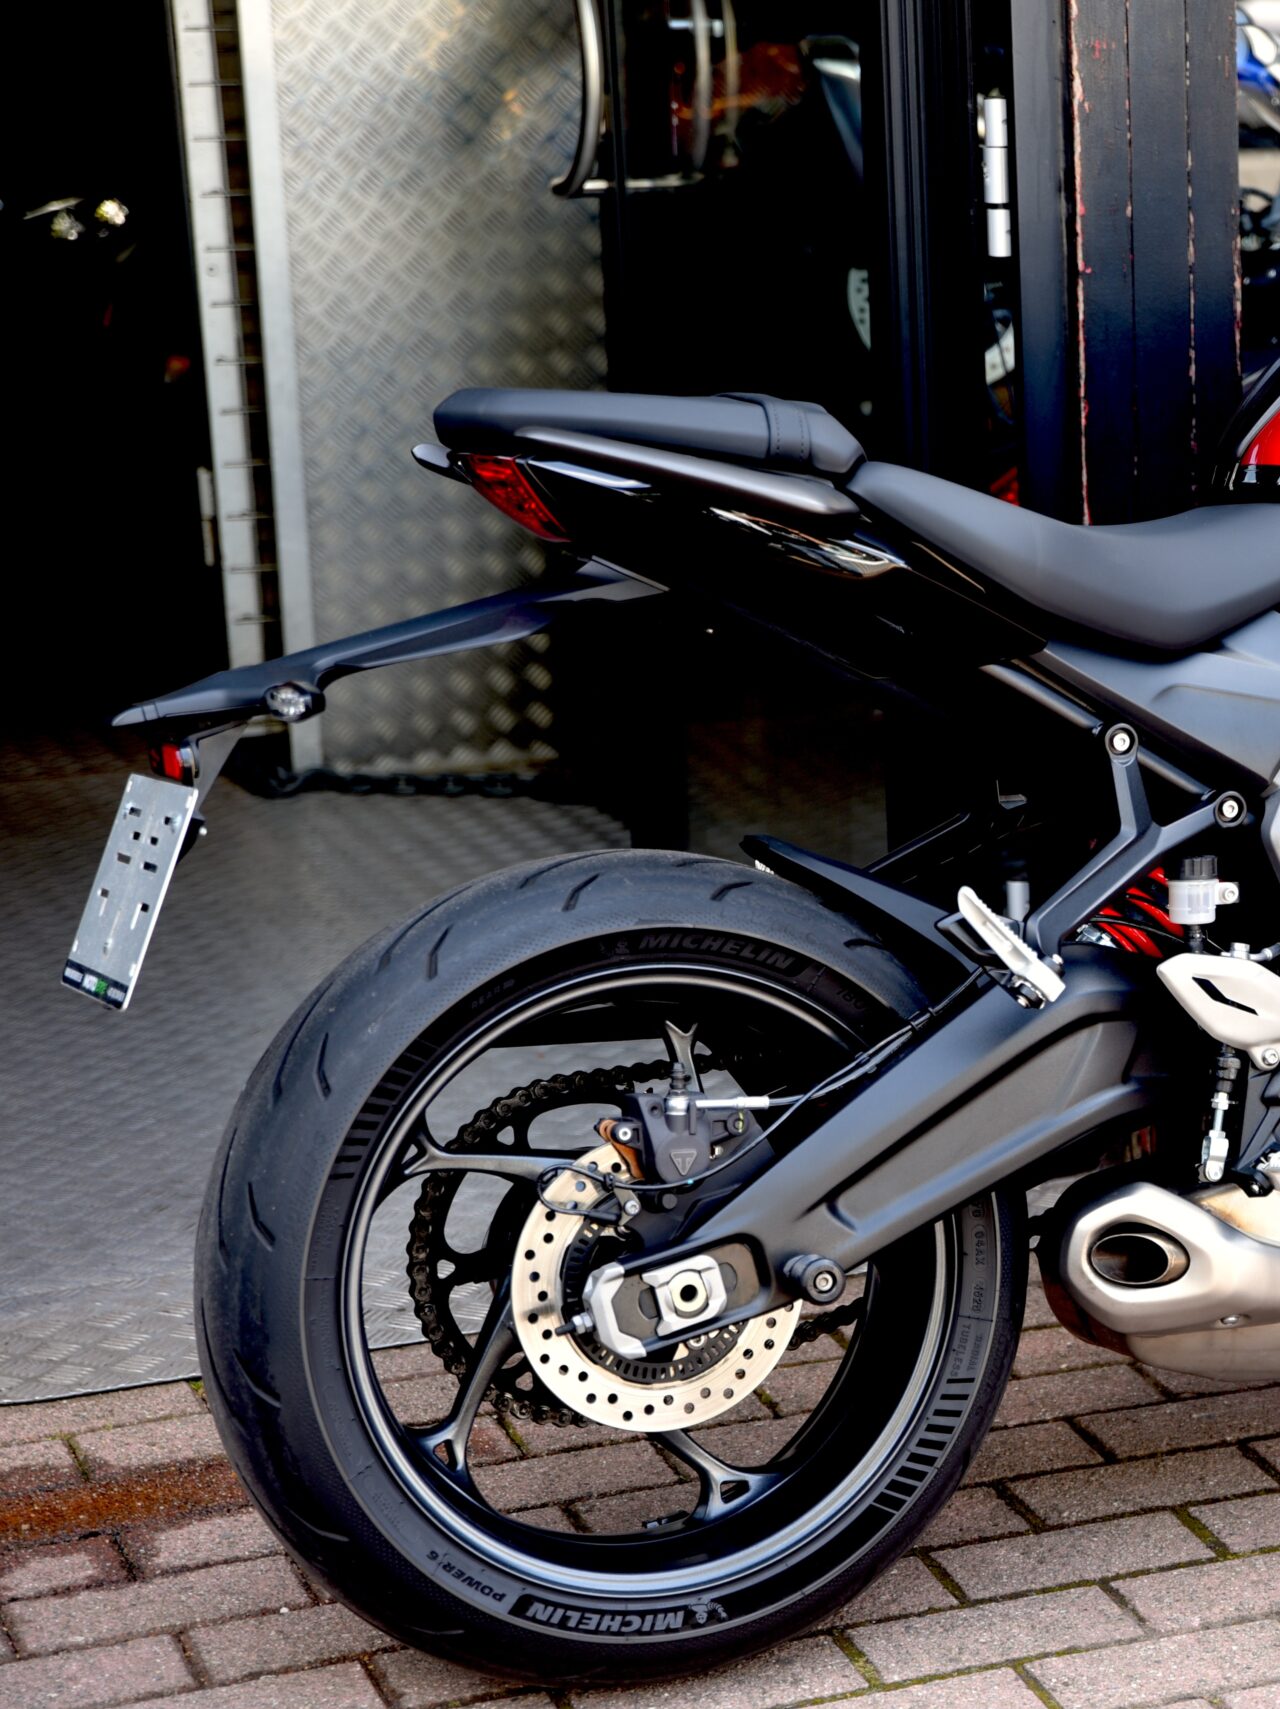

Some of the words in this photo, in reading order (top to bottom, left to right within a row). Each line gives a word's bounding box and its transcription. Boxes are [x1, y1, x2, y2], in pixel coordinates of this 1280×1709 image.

[639, 933, 797, 970] MICHELIN
[950, 1323, 972, 1378] TUBELESS
[426, 1549, 438, 1561] 6
[441, 1559, 507, 1603] POWER
[525, 1600, 685, 1633] MICHELIN
